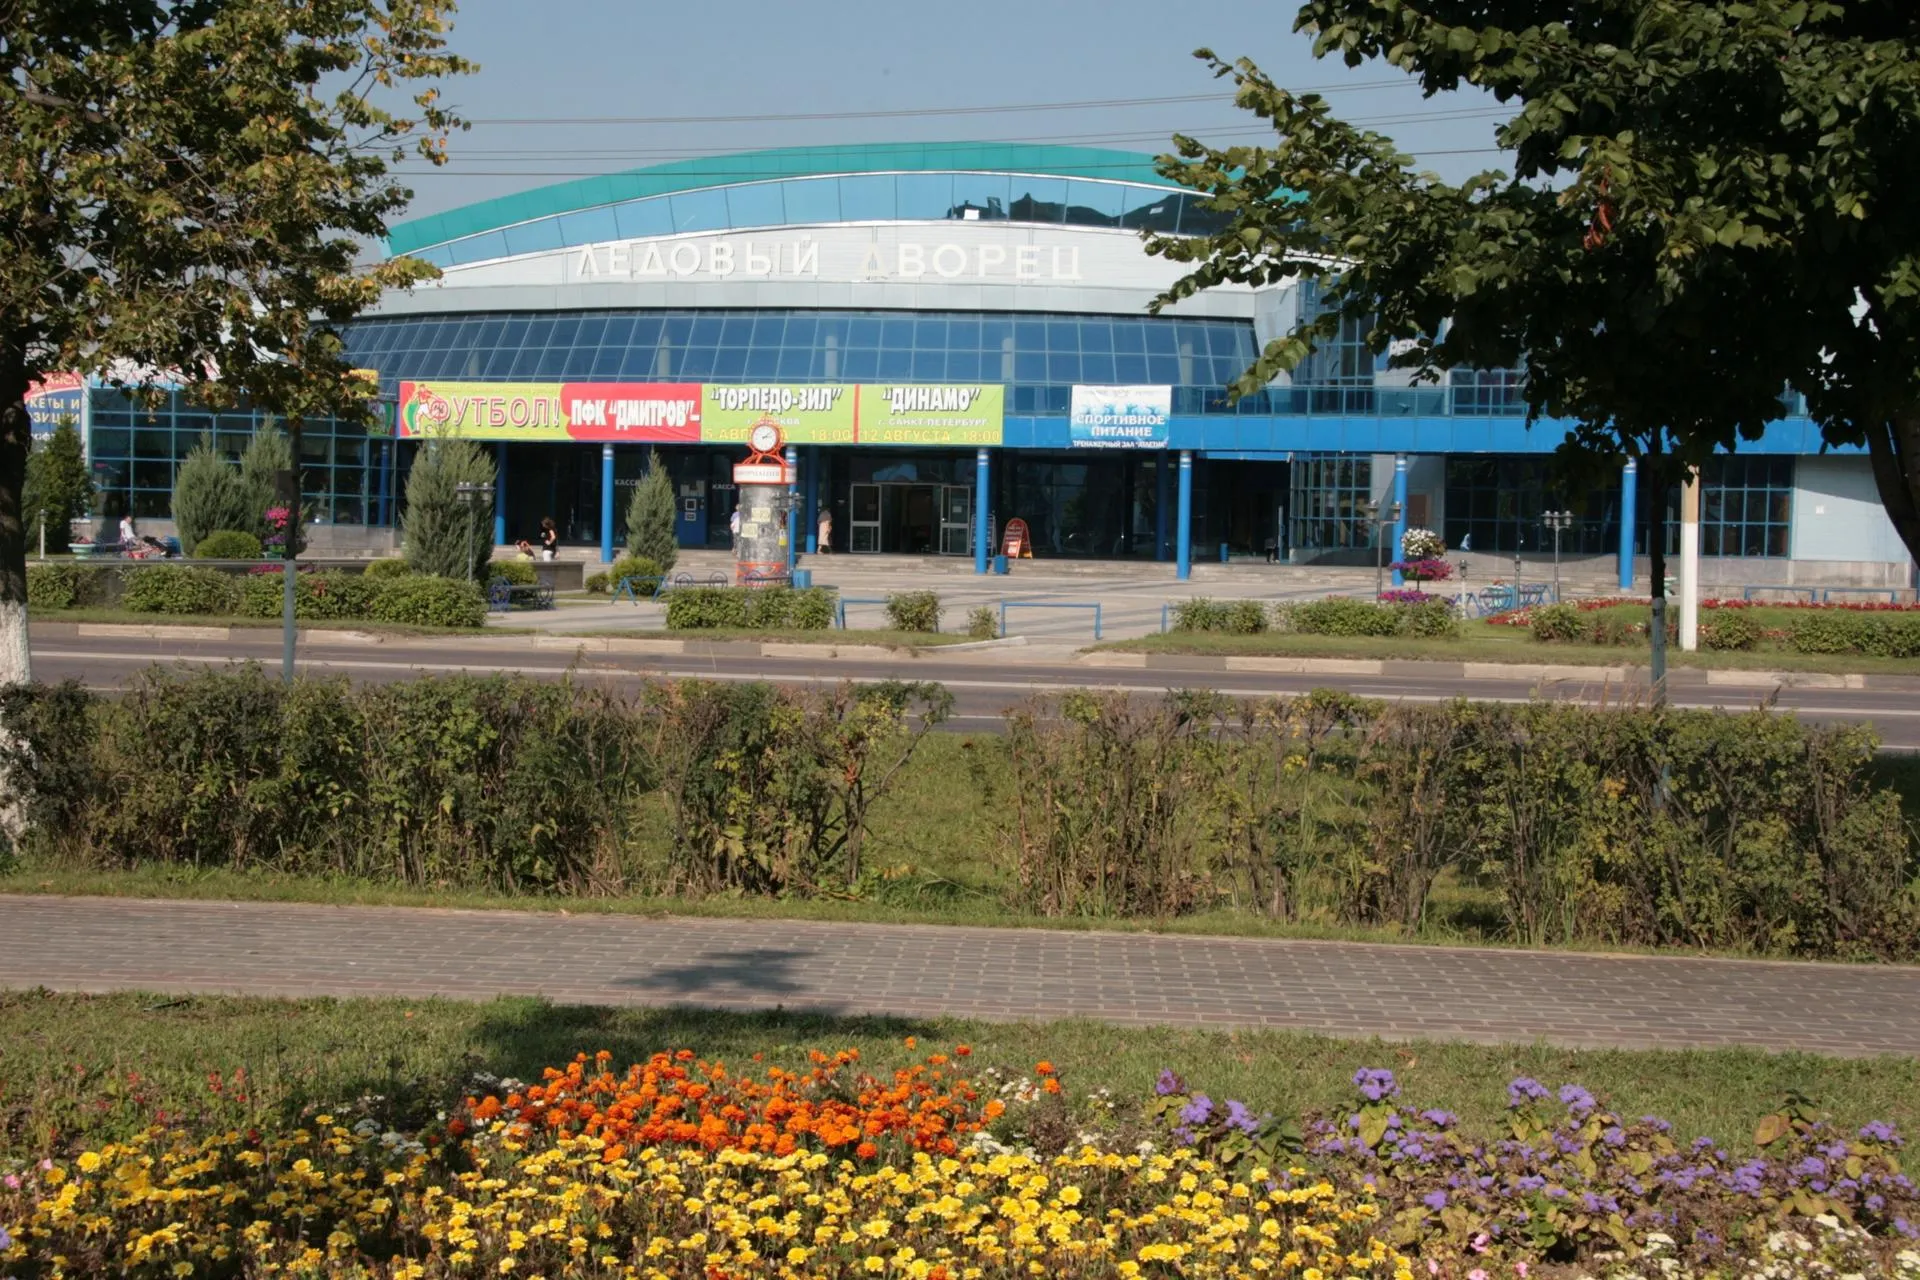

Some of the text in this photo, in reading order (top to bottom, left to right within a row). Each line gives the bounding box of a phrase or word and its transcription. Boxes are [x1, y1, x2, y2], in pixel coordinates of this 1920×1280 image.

[576, 234, 1083, 281] ЛЕДОВЫЙ ДВОРЕЦ
[430, 396, 561, 427] ФУТБОЛ!
[570, 399, 607, 427] ПФК
[711, 387, 843, 413] "ТОРПЕДО-ЗИЛ"
[882, 387, 981, 415] "ДИНАМО"
[1076, 414, 1165, 425] СПОРТИВНОЕ
[1091, 426, 1153, 437] ПИТАНИЕ
[810, 430, 851, 442] 18:00
[862, 430, 1000, 442] 12 АВГУСТА 18:00
